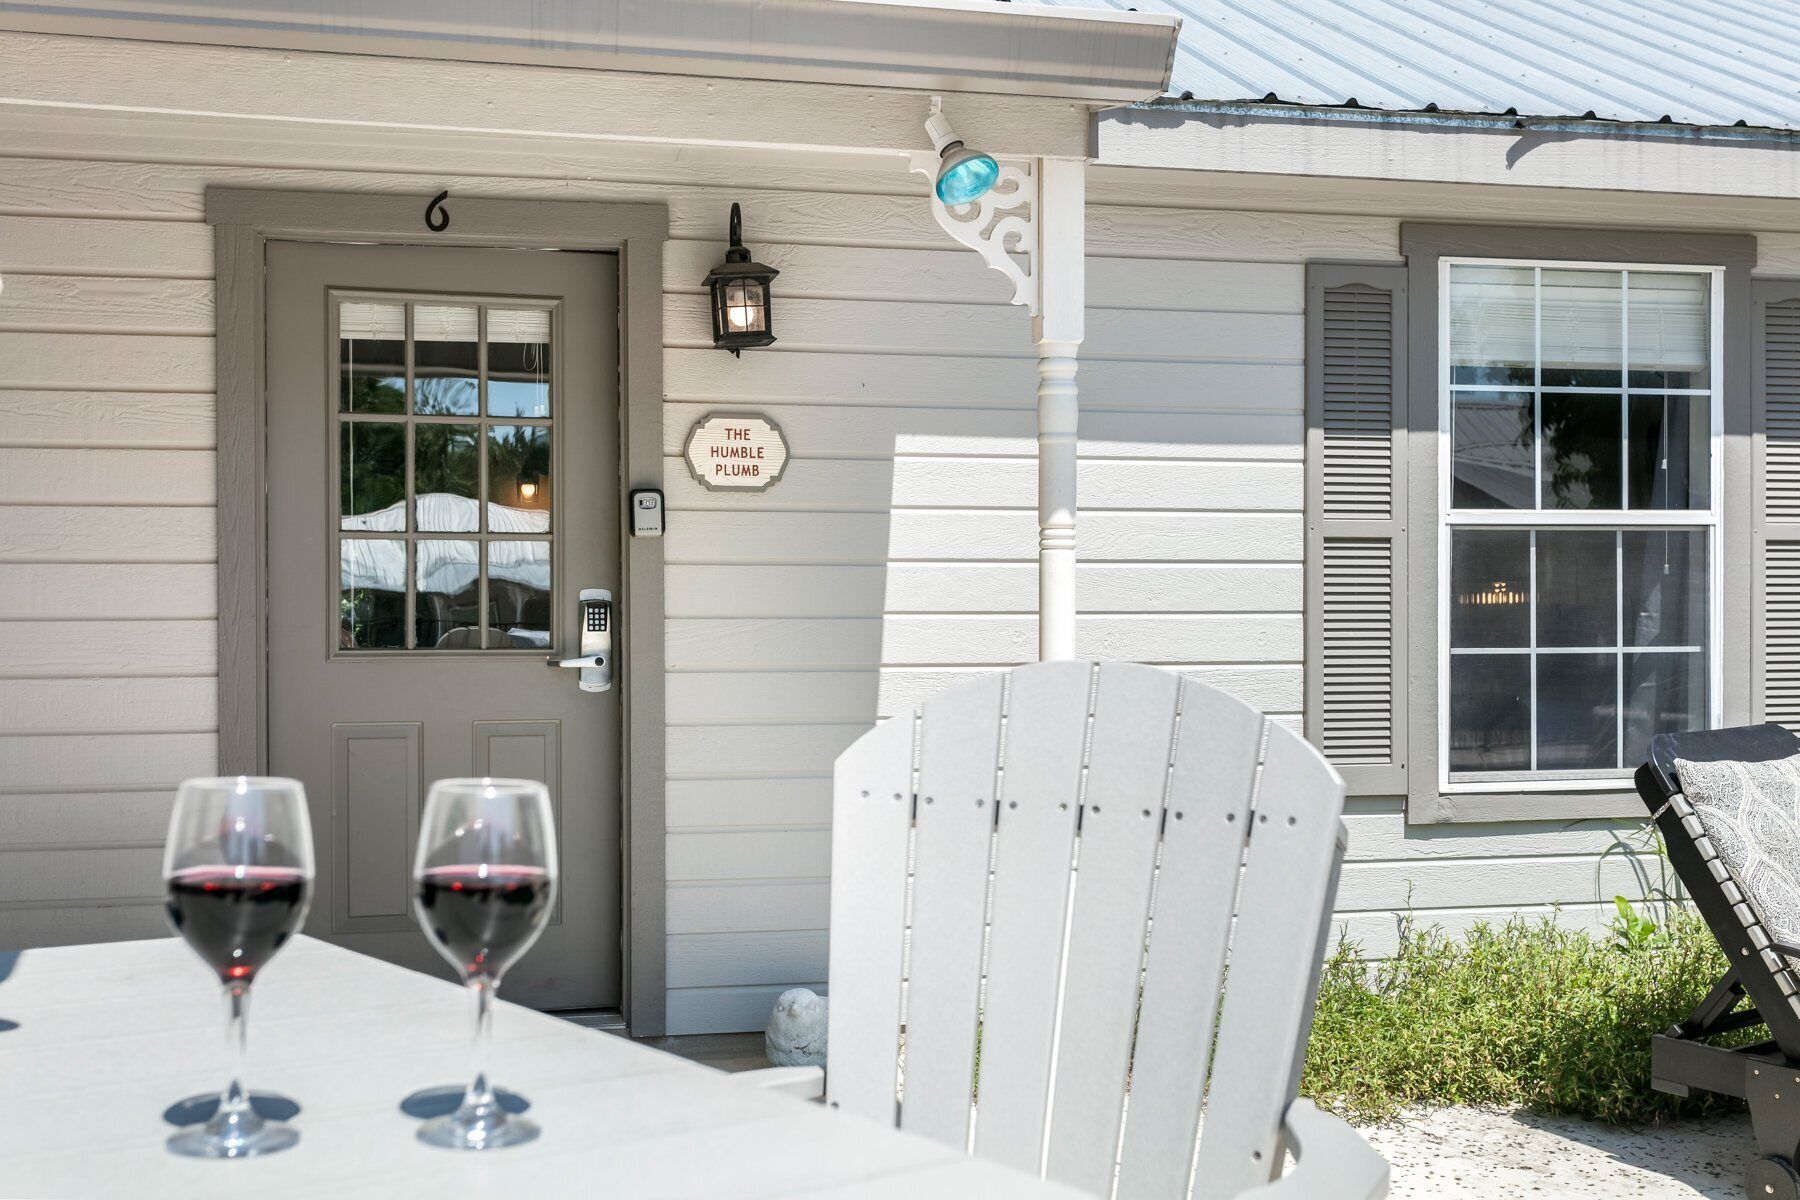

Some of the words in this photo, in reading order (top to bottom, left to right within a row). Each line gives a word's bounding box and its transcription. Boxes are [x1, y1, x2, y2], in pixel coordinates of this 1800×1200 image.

[425, 190, 449, 232] 6
[724, 428, 751, 440] THE
[710, 446, 764, 459] HUMBLE
[715, 464, 760, 476] PLUMB
